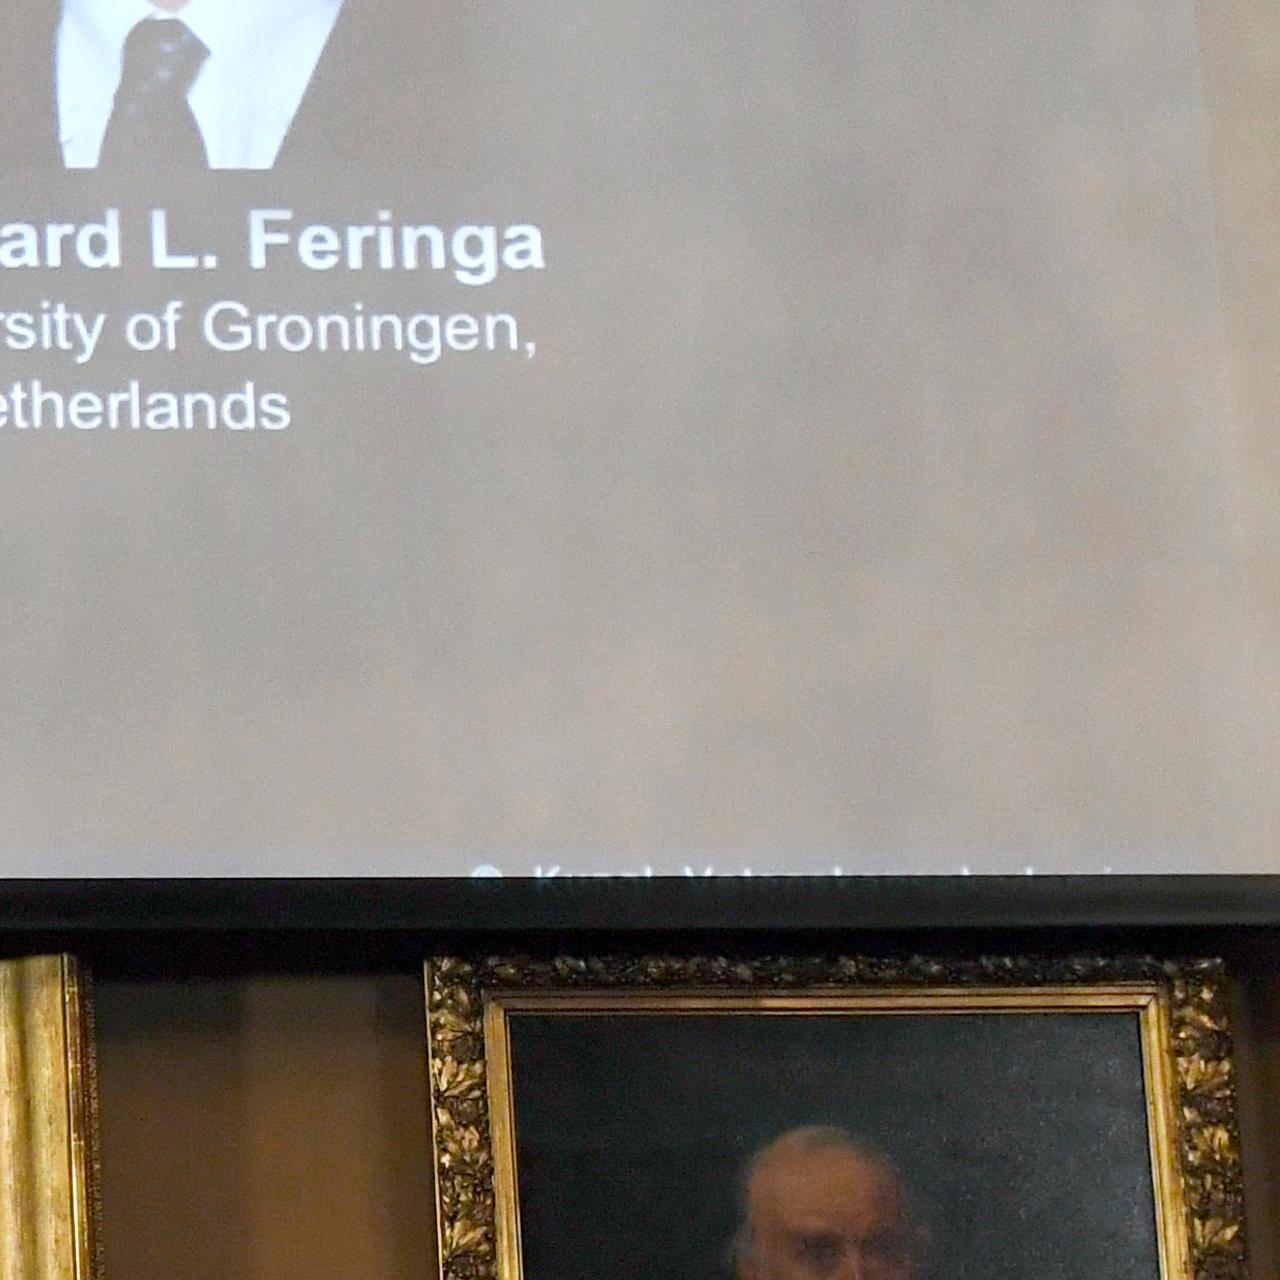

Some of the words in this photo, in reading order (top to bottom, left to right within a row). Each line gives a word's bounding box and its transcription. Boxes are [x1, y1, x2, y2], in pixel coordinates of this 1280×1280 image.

[151, 209, 217, 269] L.
[249, 209, 546, 286] Feringa
[125, 300, 183, 351] of
[203, 300, 536, 364] Groningen,
